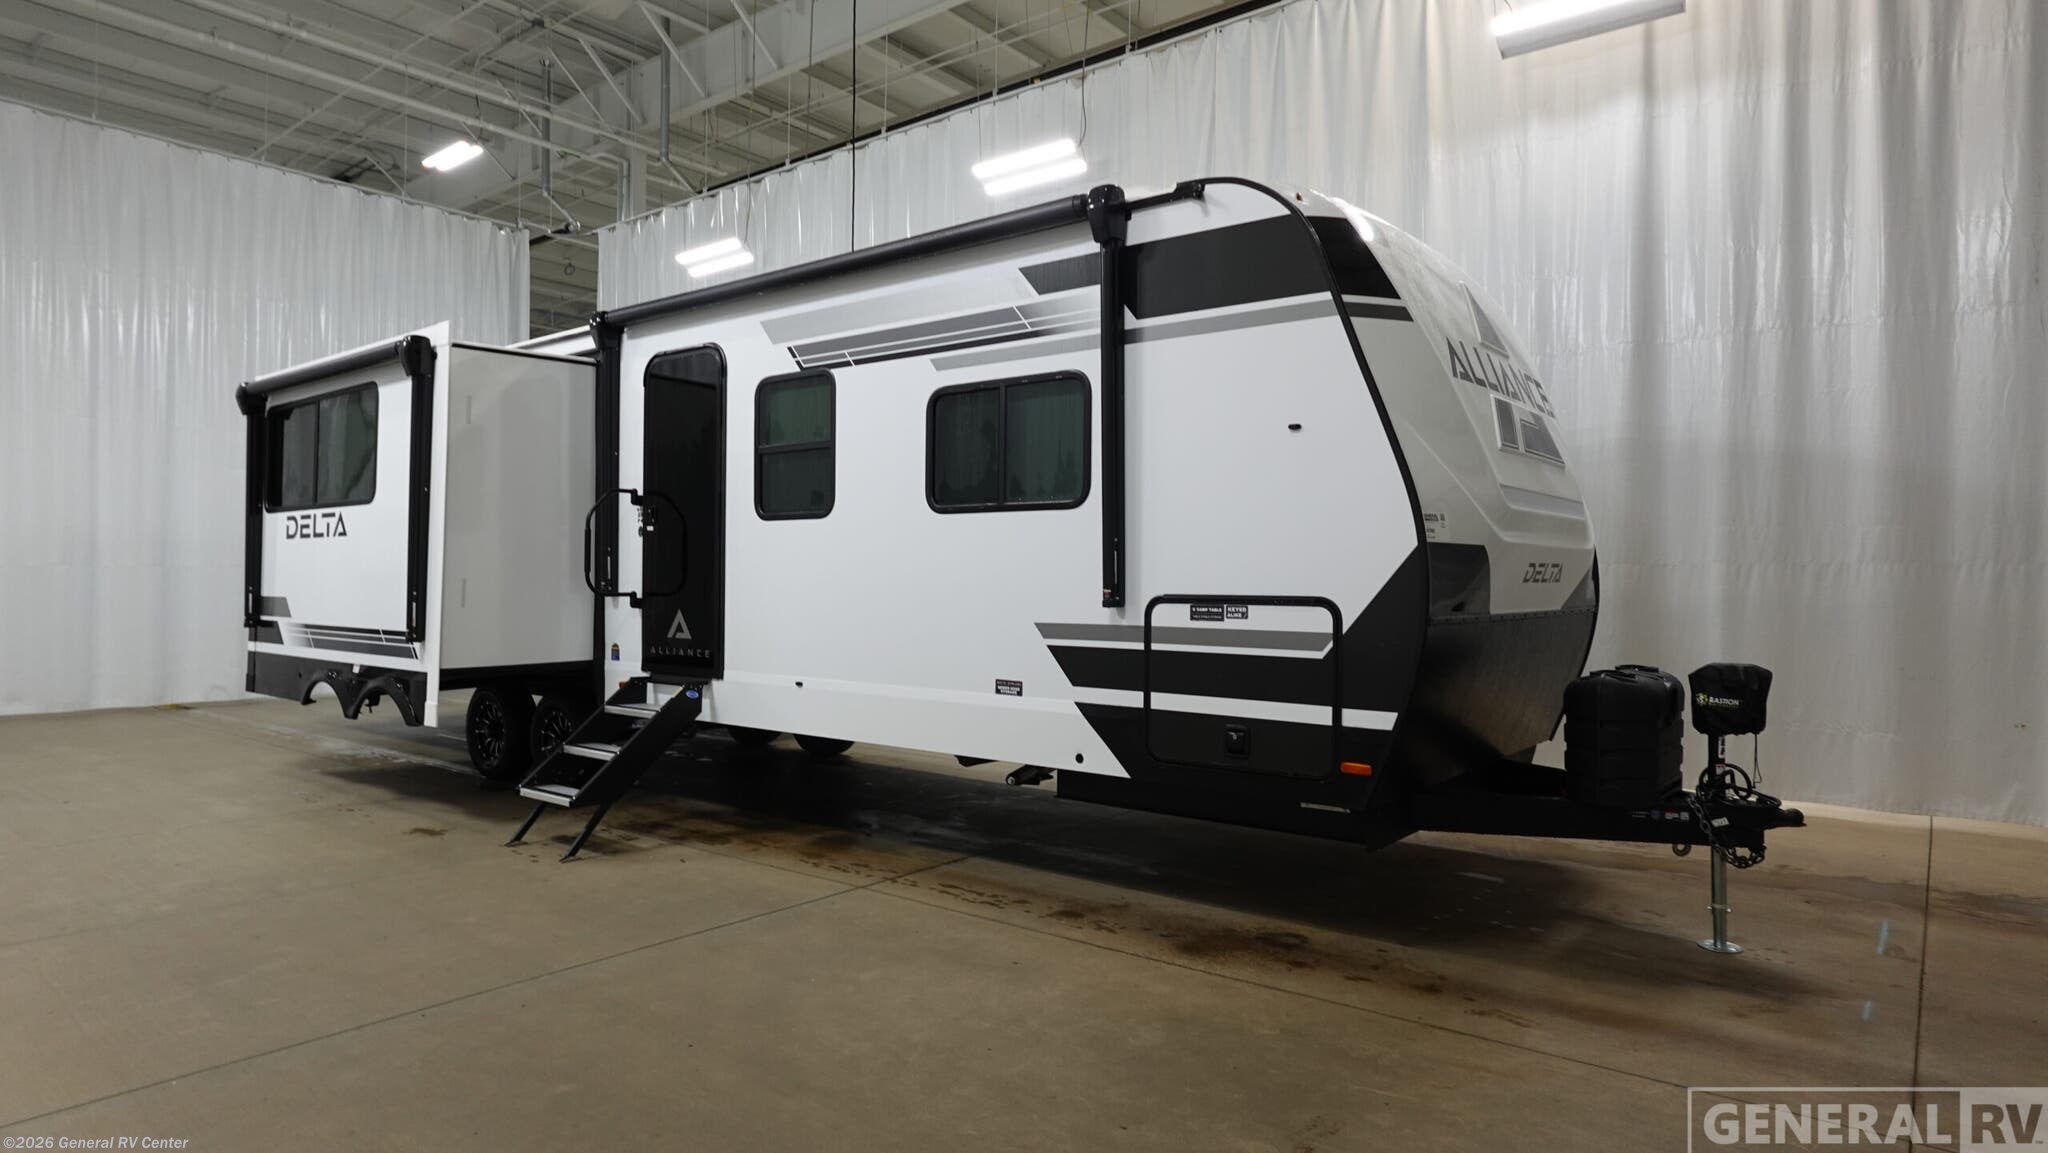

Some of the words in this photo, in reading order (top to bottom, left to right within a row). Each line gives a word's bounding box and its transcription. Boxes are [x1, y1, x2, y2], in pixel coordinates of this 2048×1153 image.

[1446, 336, 1556, 419] ALLIANCE
[286, 512, 347, 539] DELTA
[1522, 562, 1563, 583] DELTA
[650, 646, 710, 658] ALLIANCE
